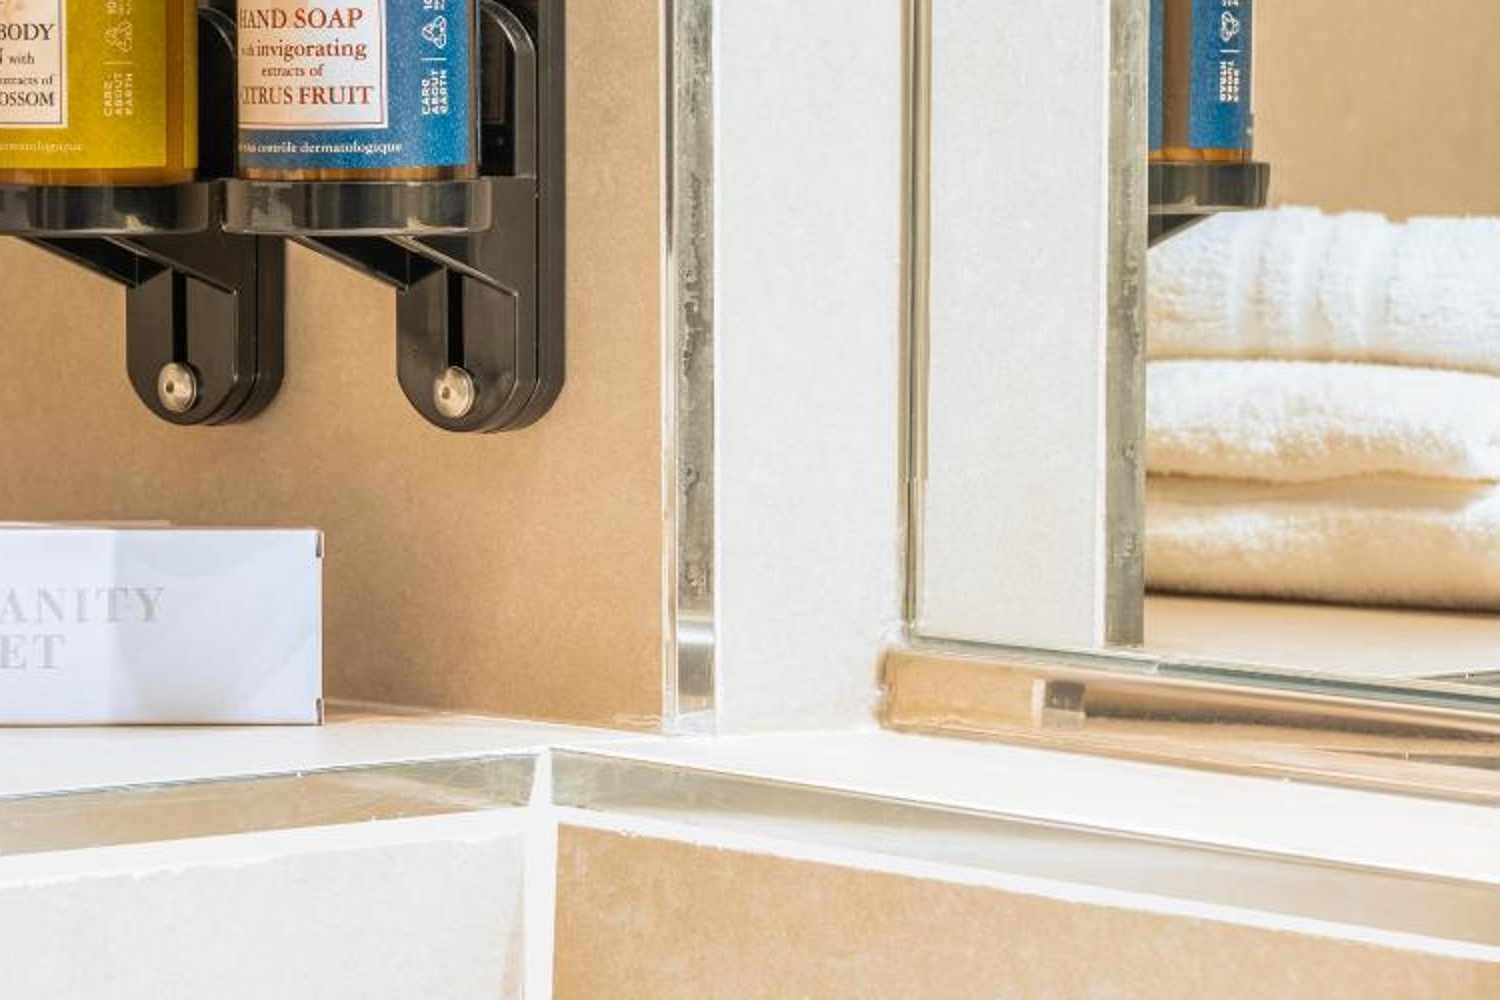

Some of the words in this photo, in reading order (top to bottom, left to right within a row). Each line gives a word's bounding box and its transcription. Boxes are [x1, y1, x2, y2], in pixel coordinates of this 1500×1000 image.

[239, 7, 288, 29] HAND
[293, 7, 363, 29] SOAP
[8, 51, 35, 65] with
[257, 37, 368, 62] invigorating
[261, 66, 305, 77] extracts
[309, 63, 324, 77] of
[240, 85, 293, 105] ITRUS
[299, 85, 374, 105] FRUIT
